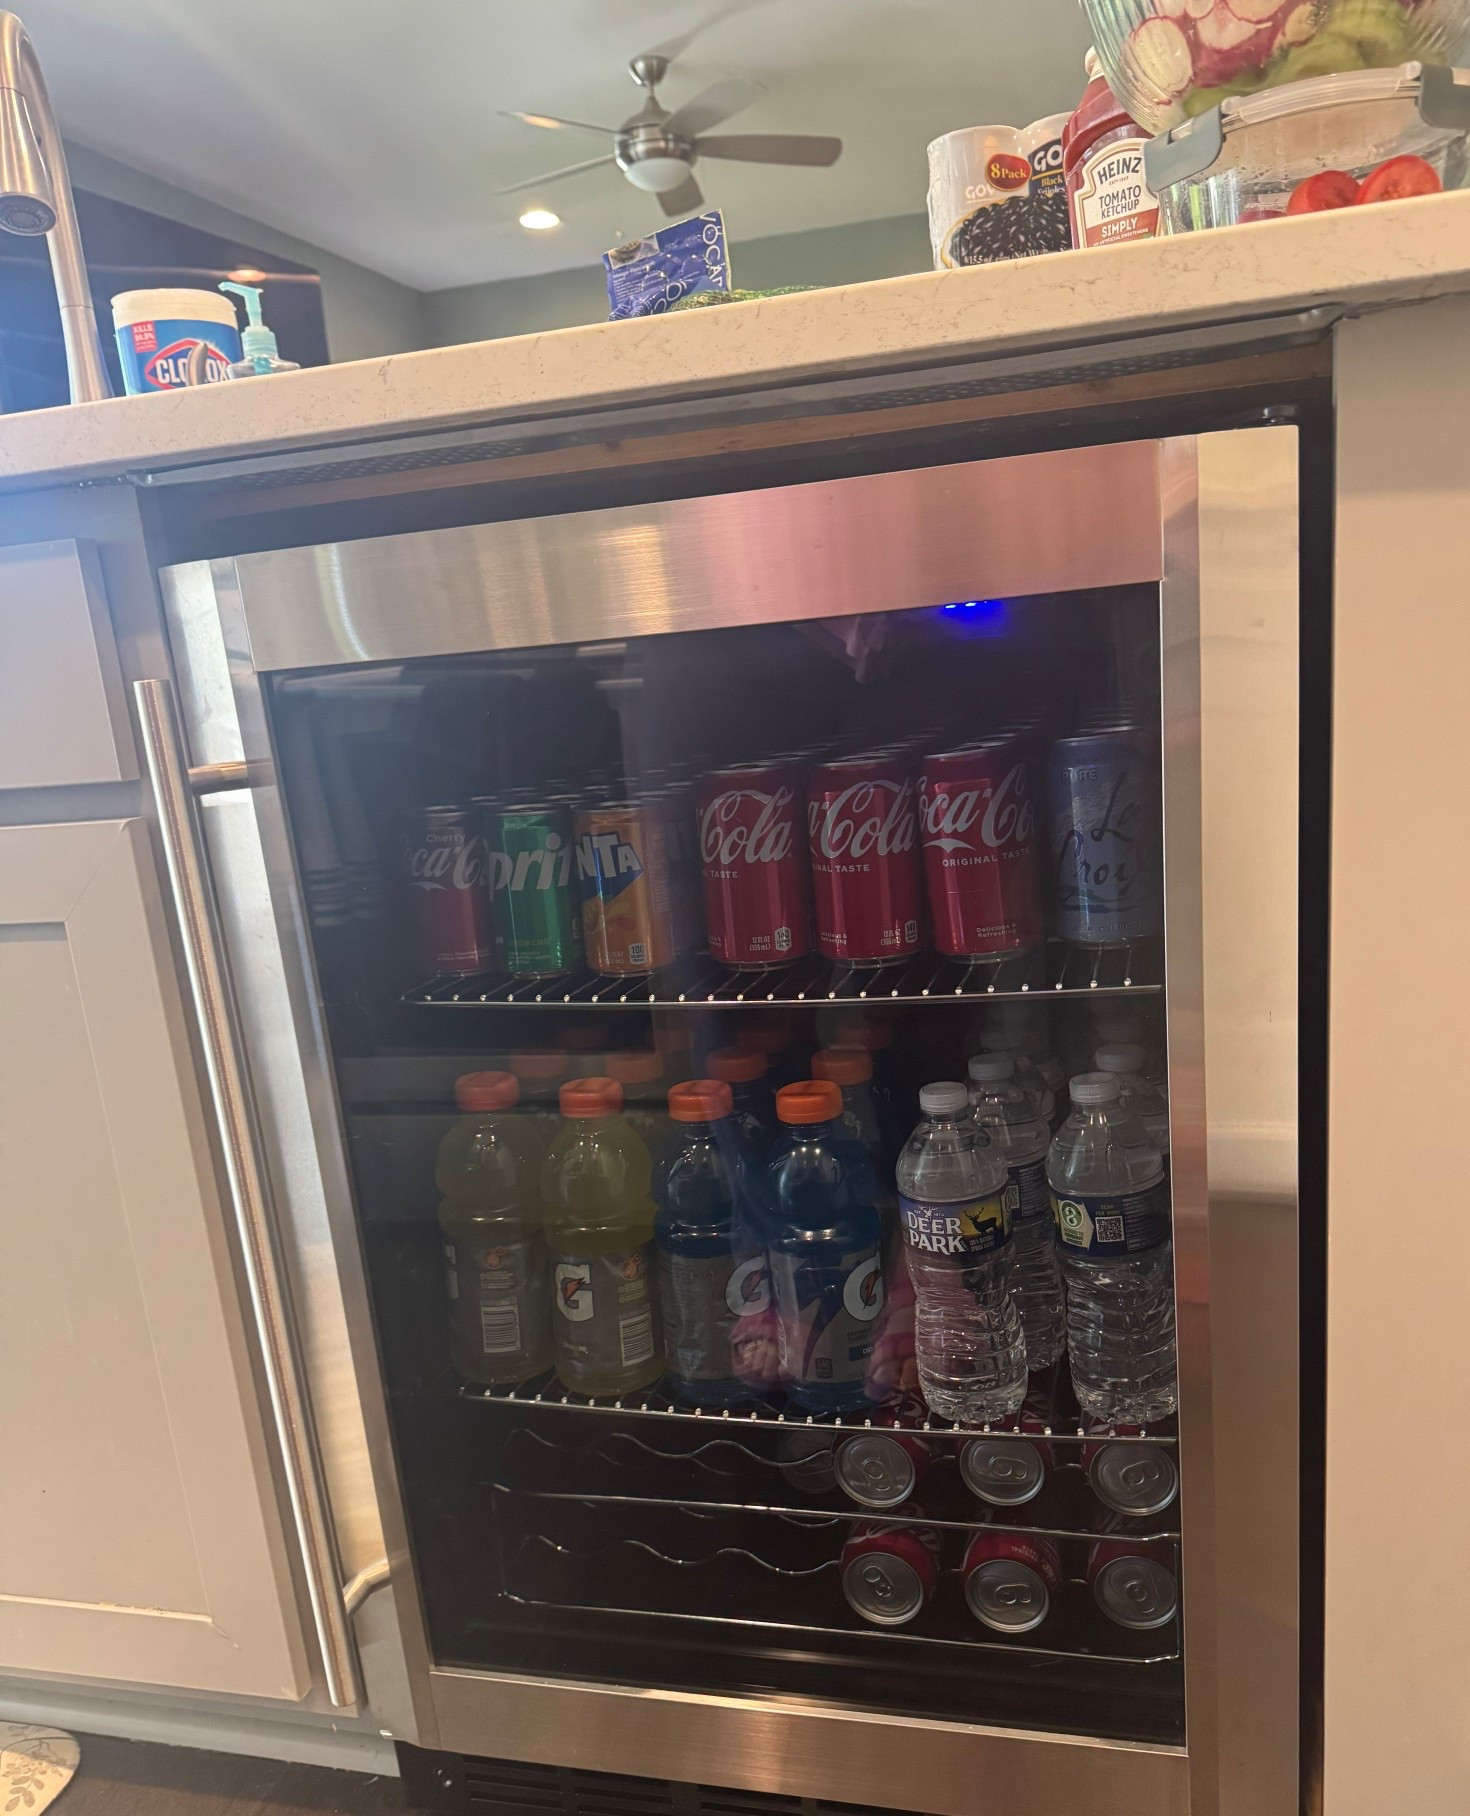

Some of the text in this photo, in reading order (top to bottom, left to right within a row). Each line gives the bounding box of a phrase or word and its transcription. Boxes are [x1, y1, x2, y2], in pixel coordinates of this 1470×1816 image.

[1033, 143, 1063, 171] GO
[990, 162, 1027, 179] 8 Pack
[1097, 156, 1142, 185] HEINZ
[1041, 175, 1063, 187] Black
[1098, 184, 1141, 209] TOMATO
[1101, 198, 1139, 220] KETCHUP
[1101, 216, 1138, 238] SIMPLY
[1121, 227, 1149, 239] SWEETENERS
[155, 358, 229, 385] CLOOX
[425, 833, 466, 844] Cherry
[575, 832, 642, 881] NTA
[942, 854, 998, 867] ORIGINAL
[710, 870, 739, 879] TASTE
[834, 863, 871, 873] TASTE
[976, 924, 1011, 934] Delicious
[977, 928, 1017, 938] Refreshing
[631, 945, 645, 954] 100
[906, 1210, 963, 1235] DEER
[909, 1228, 966, 1256] PARK
